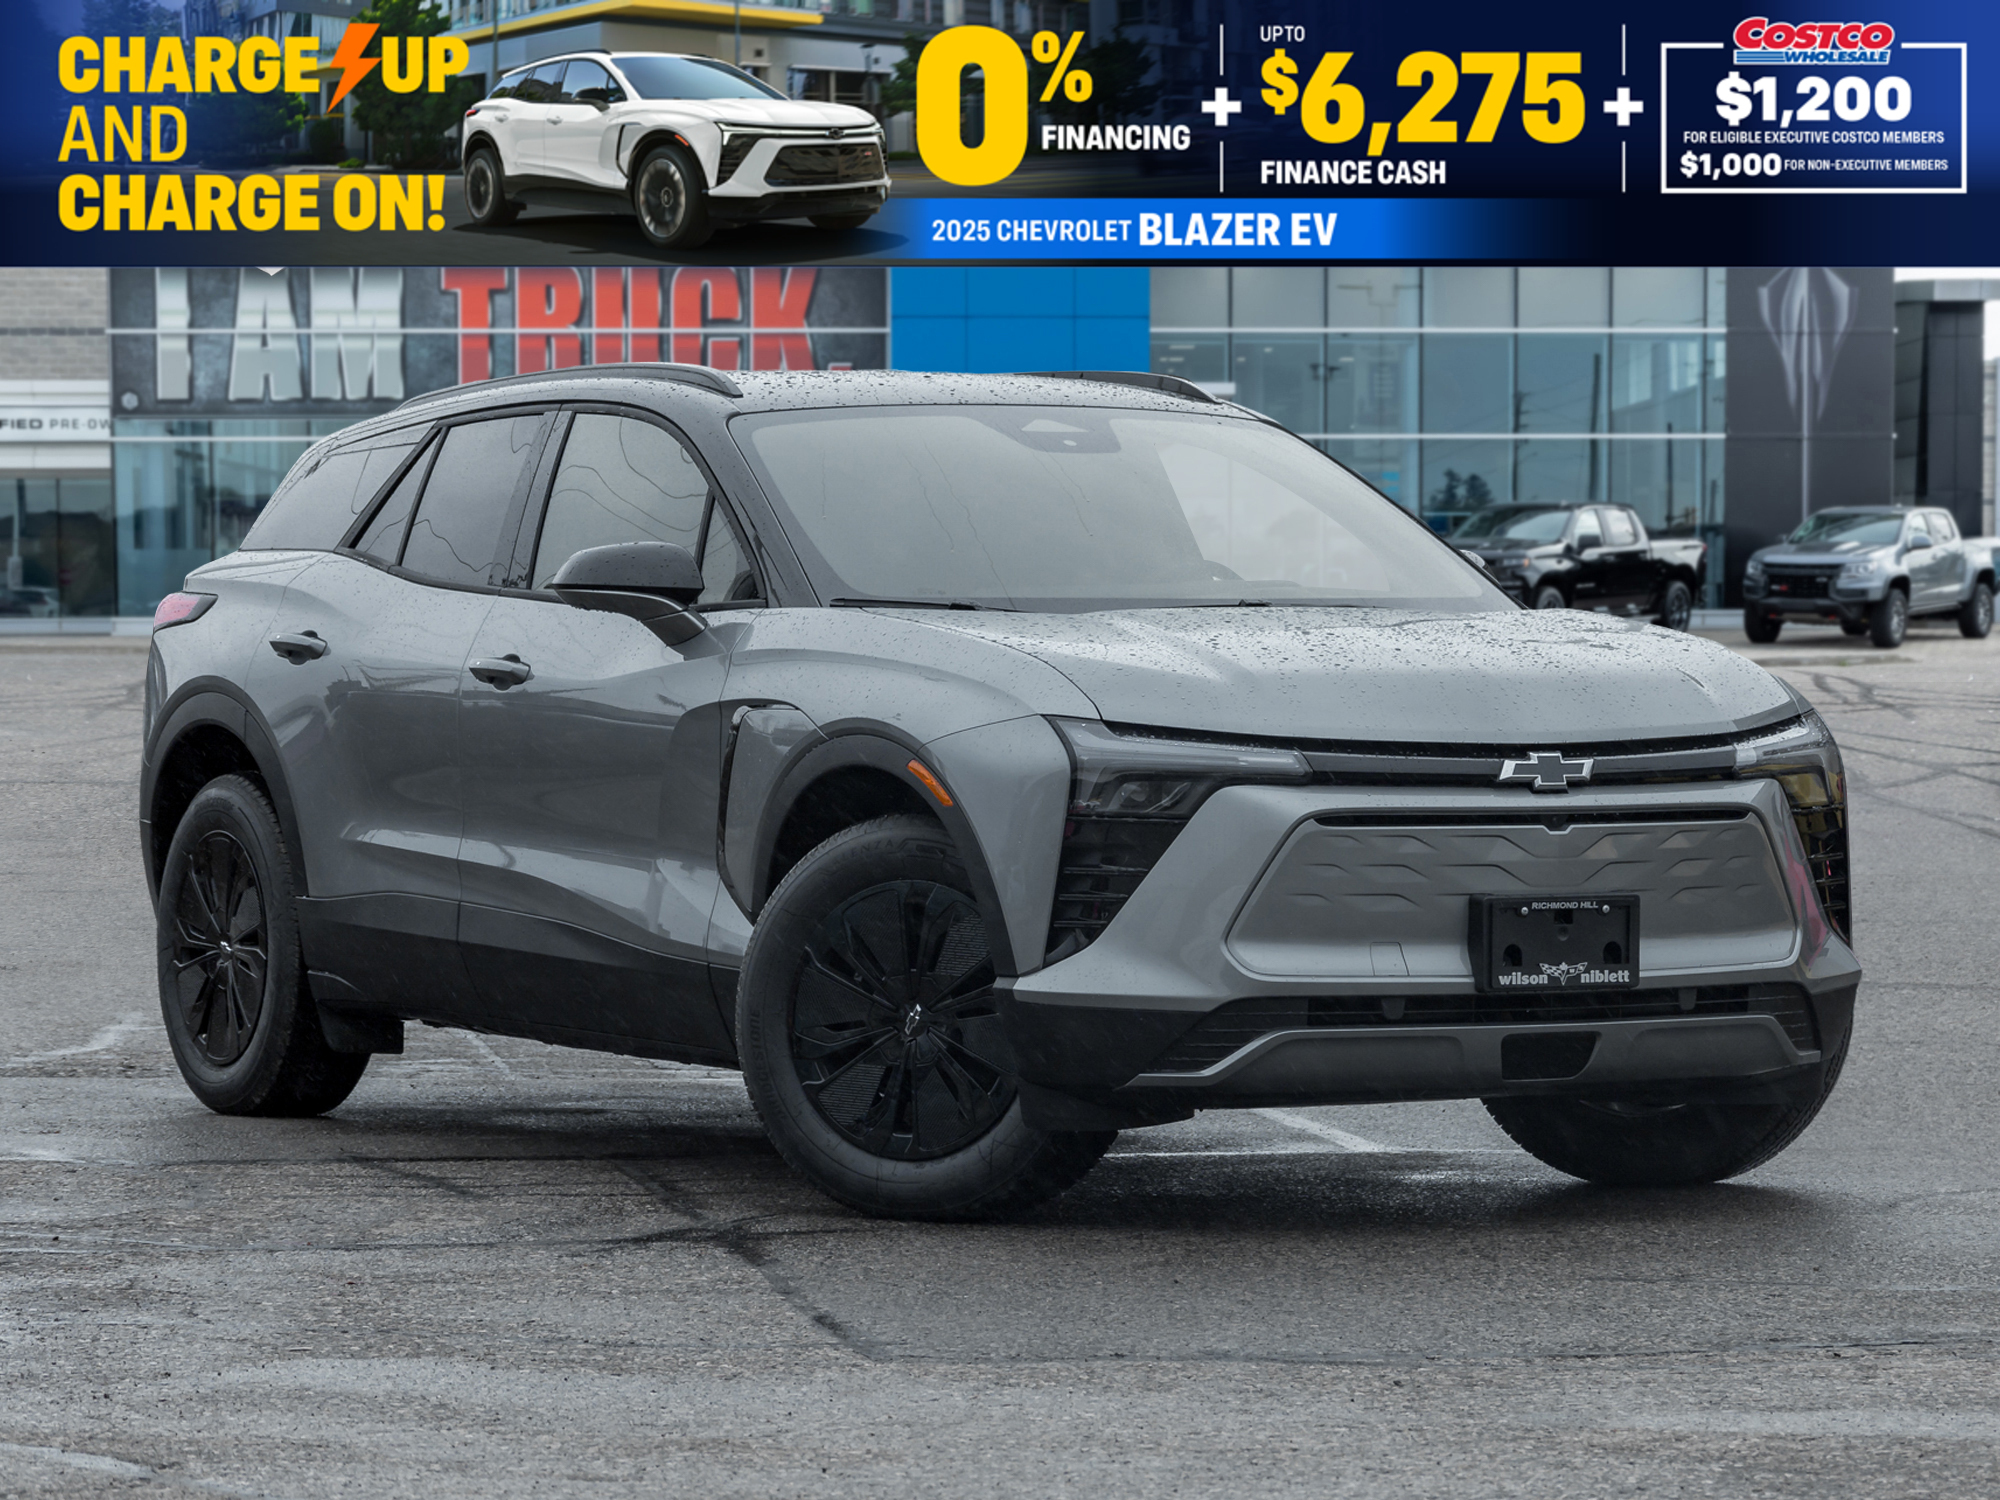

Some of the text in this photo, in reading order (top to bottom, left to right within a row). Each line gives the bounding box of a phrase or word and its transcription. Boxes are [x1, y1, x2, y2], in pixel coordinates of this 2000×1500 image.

[228, 267, 403, 400] AM
[1531, 900, 1599, 910] RICHMOND HILL
[1498, 969, 1630, 986] wilson niblett
